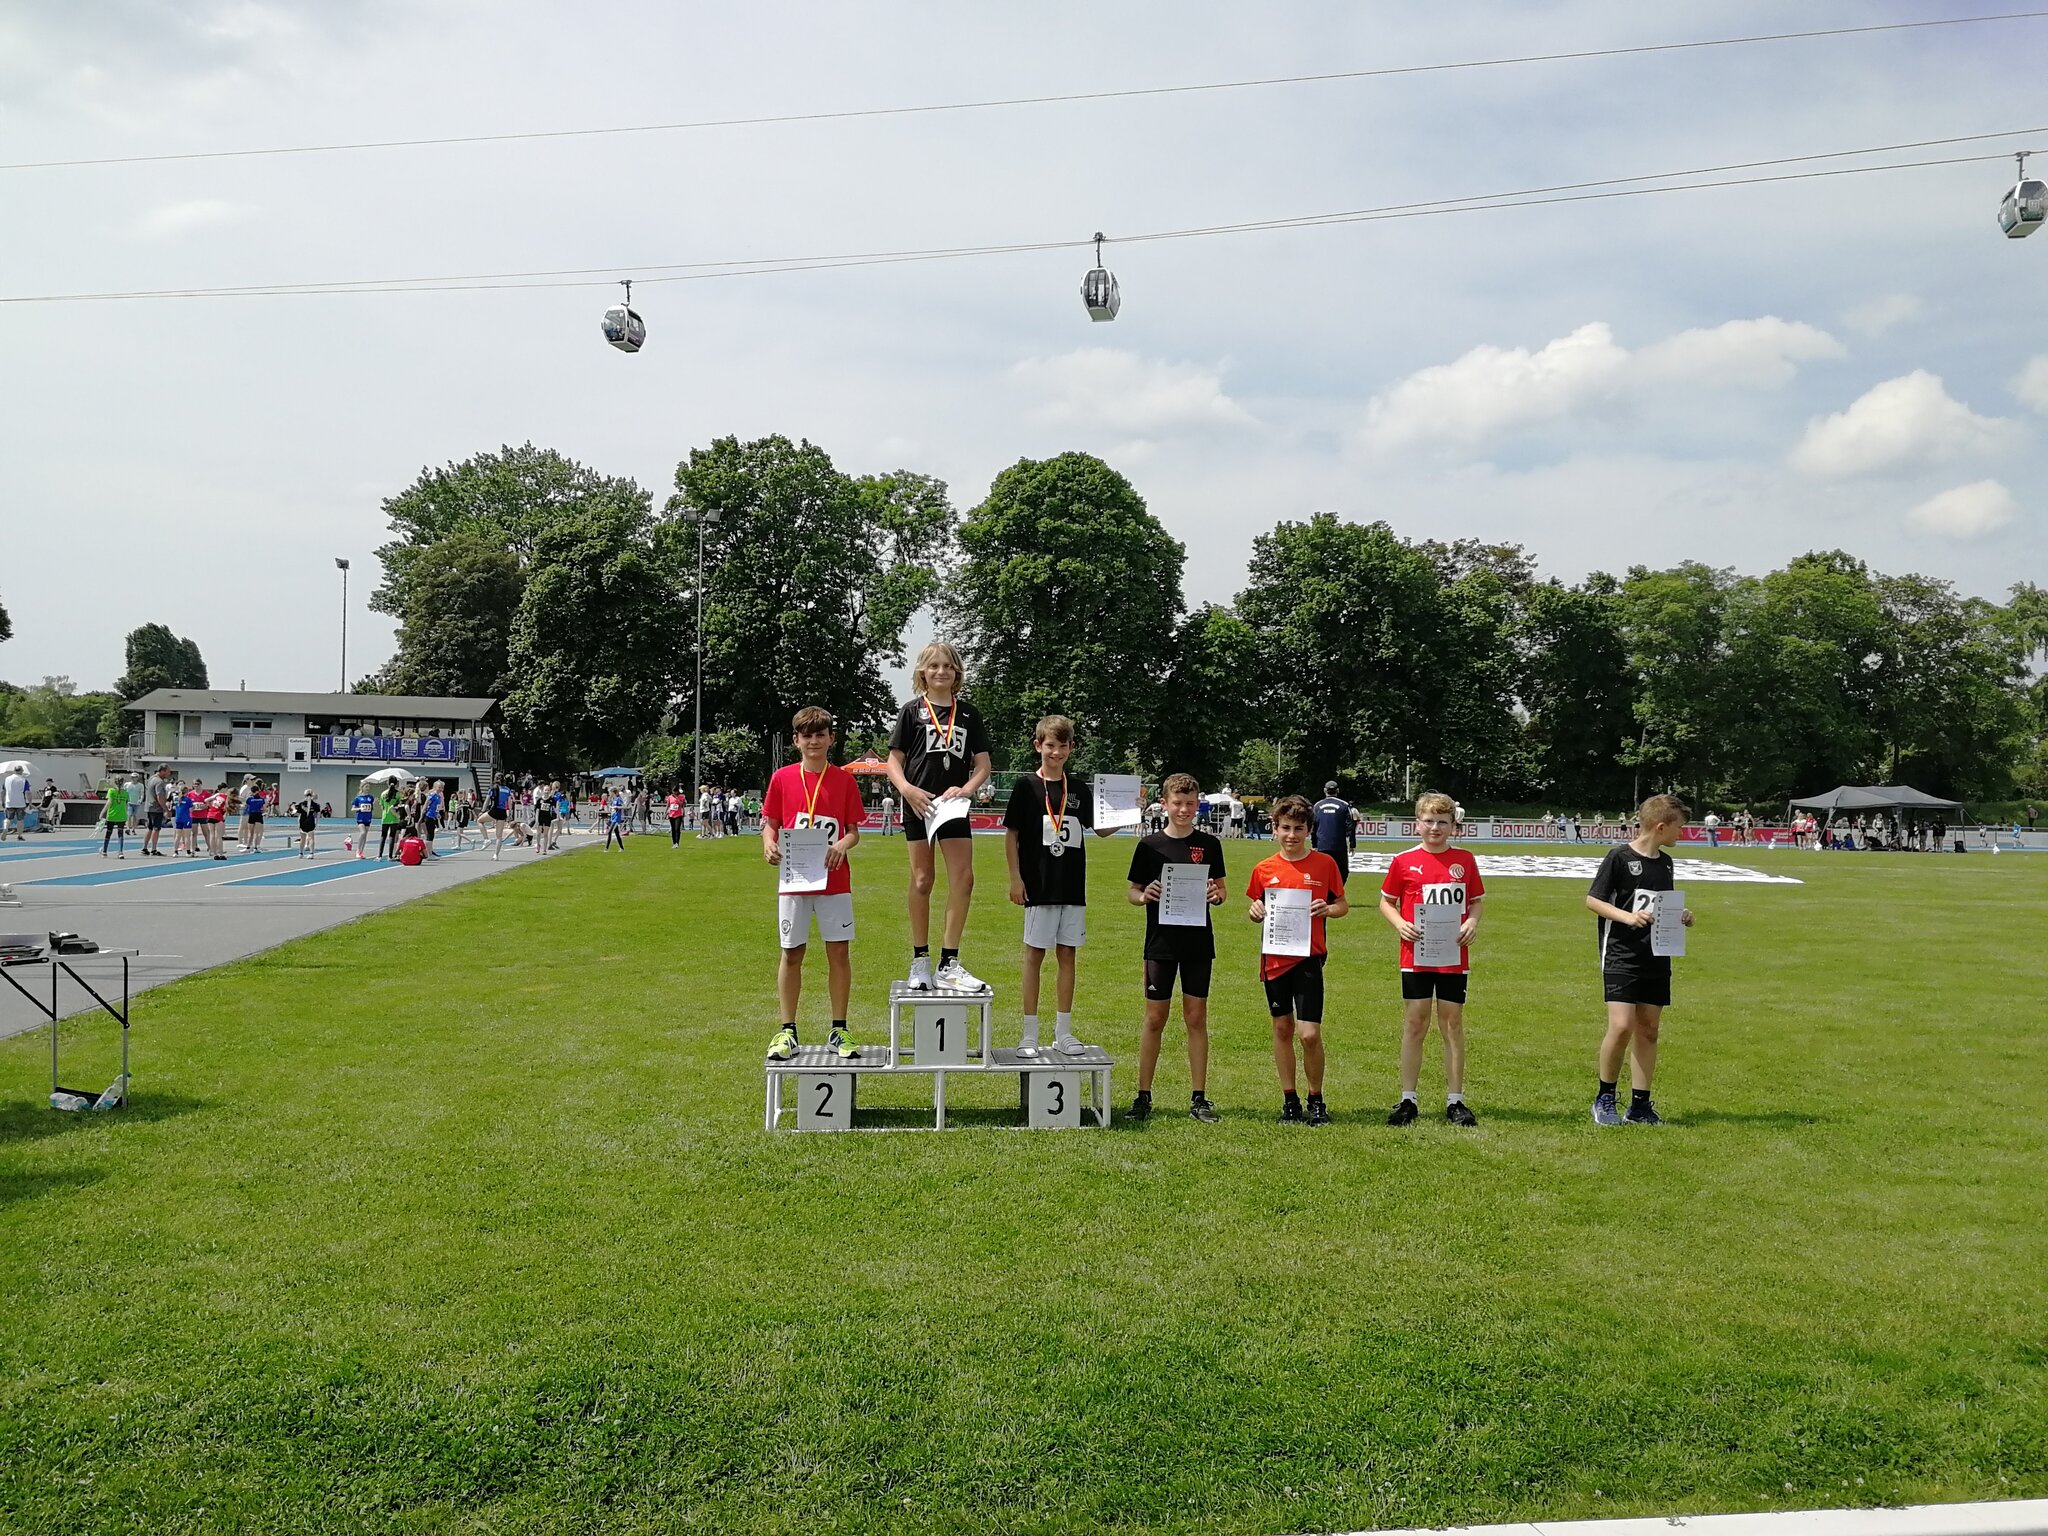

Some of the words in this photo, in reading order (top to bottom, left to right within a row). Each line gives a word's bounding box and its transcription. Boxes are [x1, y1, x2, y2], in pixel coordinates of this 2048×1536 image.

[1060, 820, 1070, 842] 5
[1355, 823, 1387, 835] AUS
[1401, 823, 1478, 836] BAUS
[1637, 894, 1656, 912] 2
[935, 1017, 946, 1052] 1
[814, 1082, 834, 1118] 2
[1046, 1081, 1065, 1116] 3
